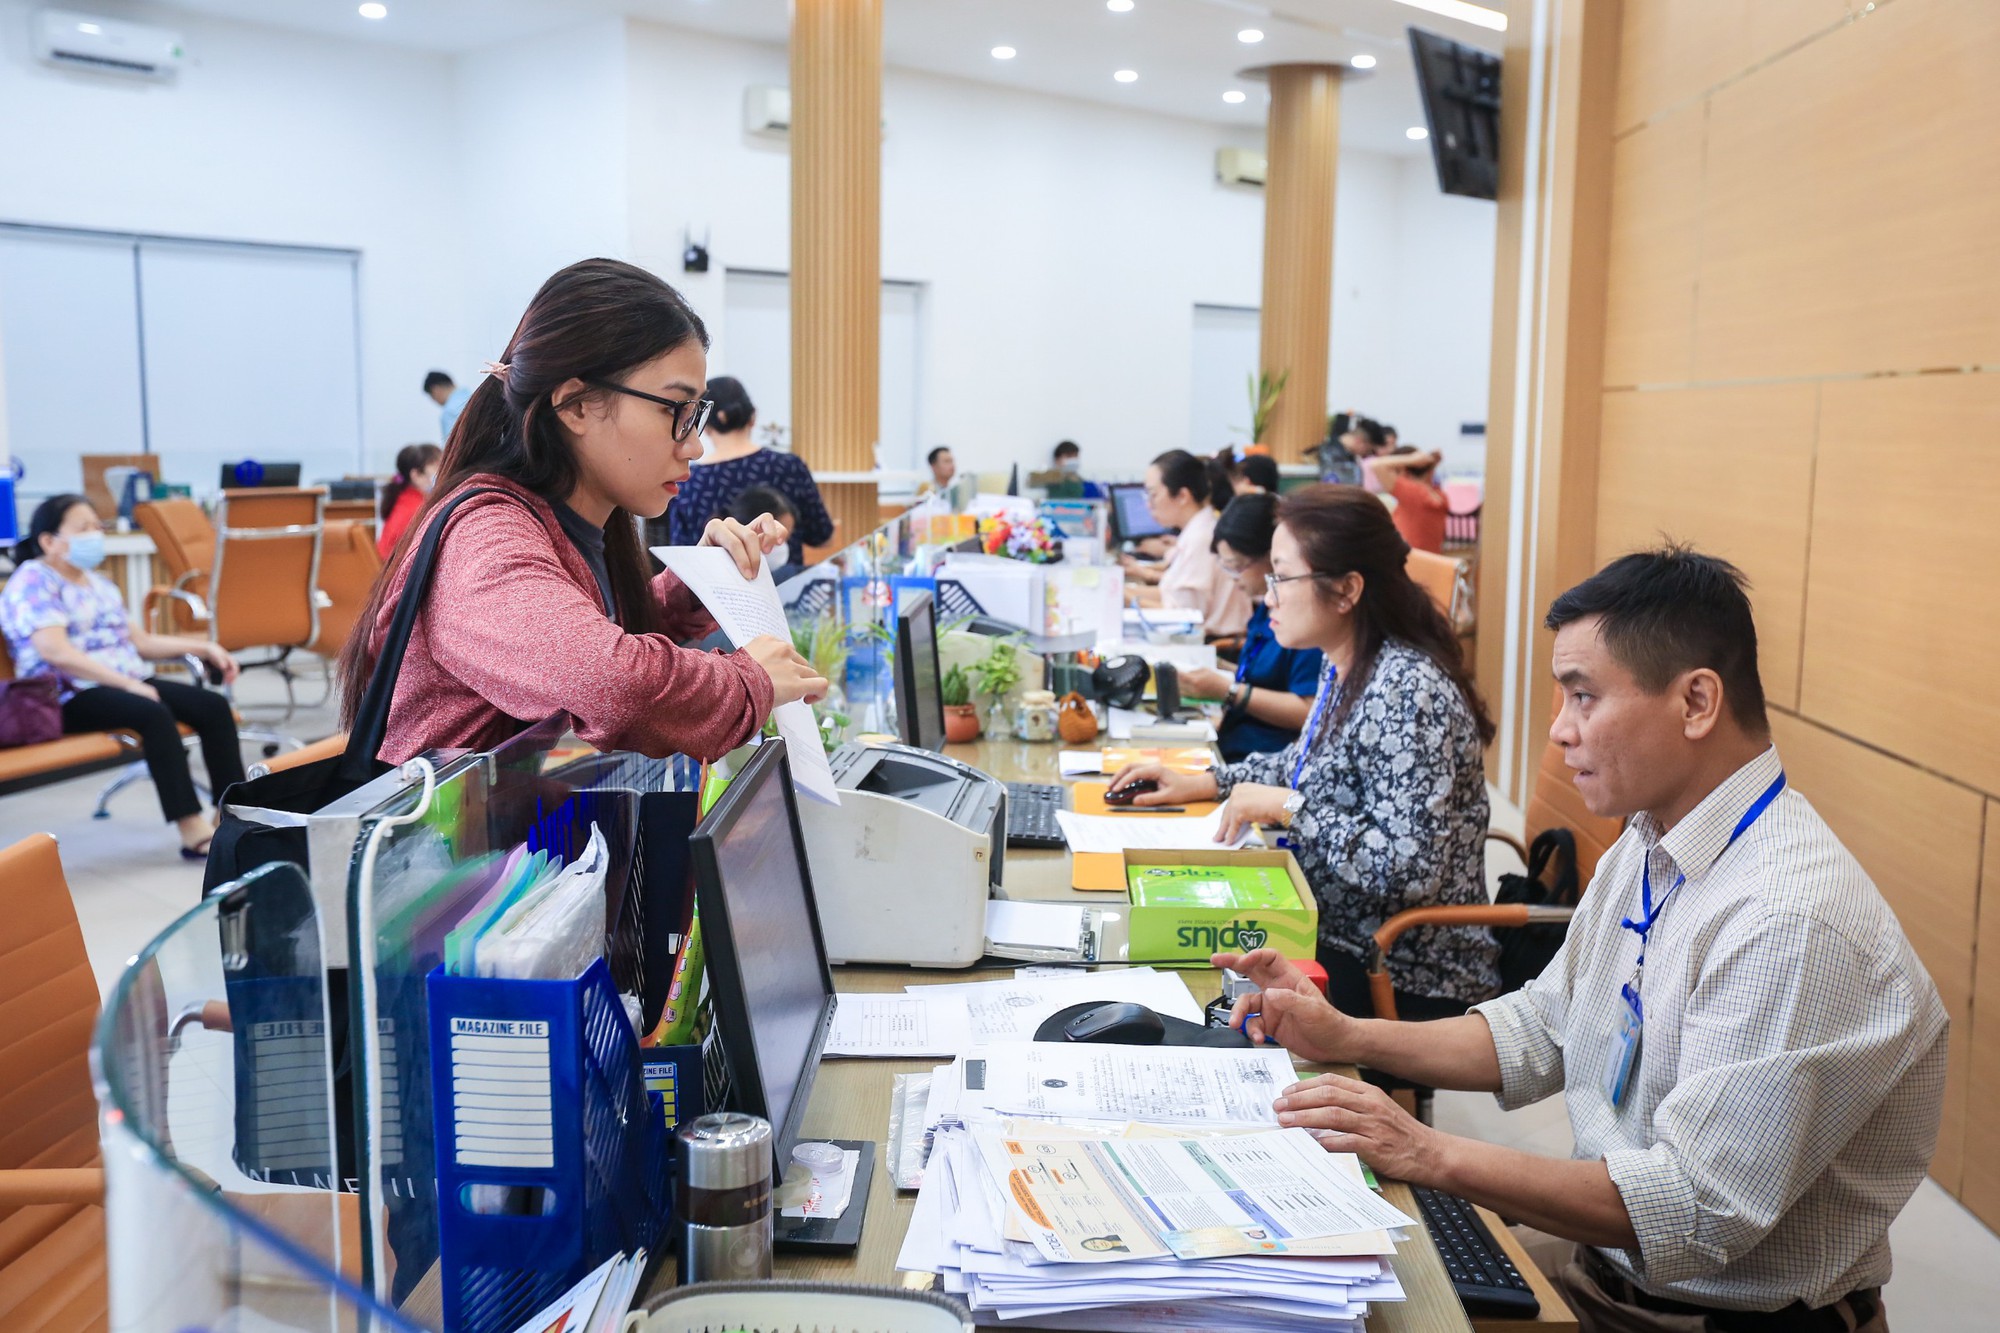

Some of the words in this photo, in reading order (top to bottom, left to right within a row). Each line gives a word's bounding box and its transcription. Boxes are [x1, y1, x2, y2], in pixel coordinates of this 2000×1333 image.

[1177, 920, 1239, 954] plus
[456, 1020, 515, 1034] MAGAZINE
[519, 1023, 543, 1035] FILE
[643, 1067, 657, 1075] ZINE
[658, 1066, 673, 1074] FILE
